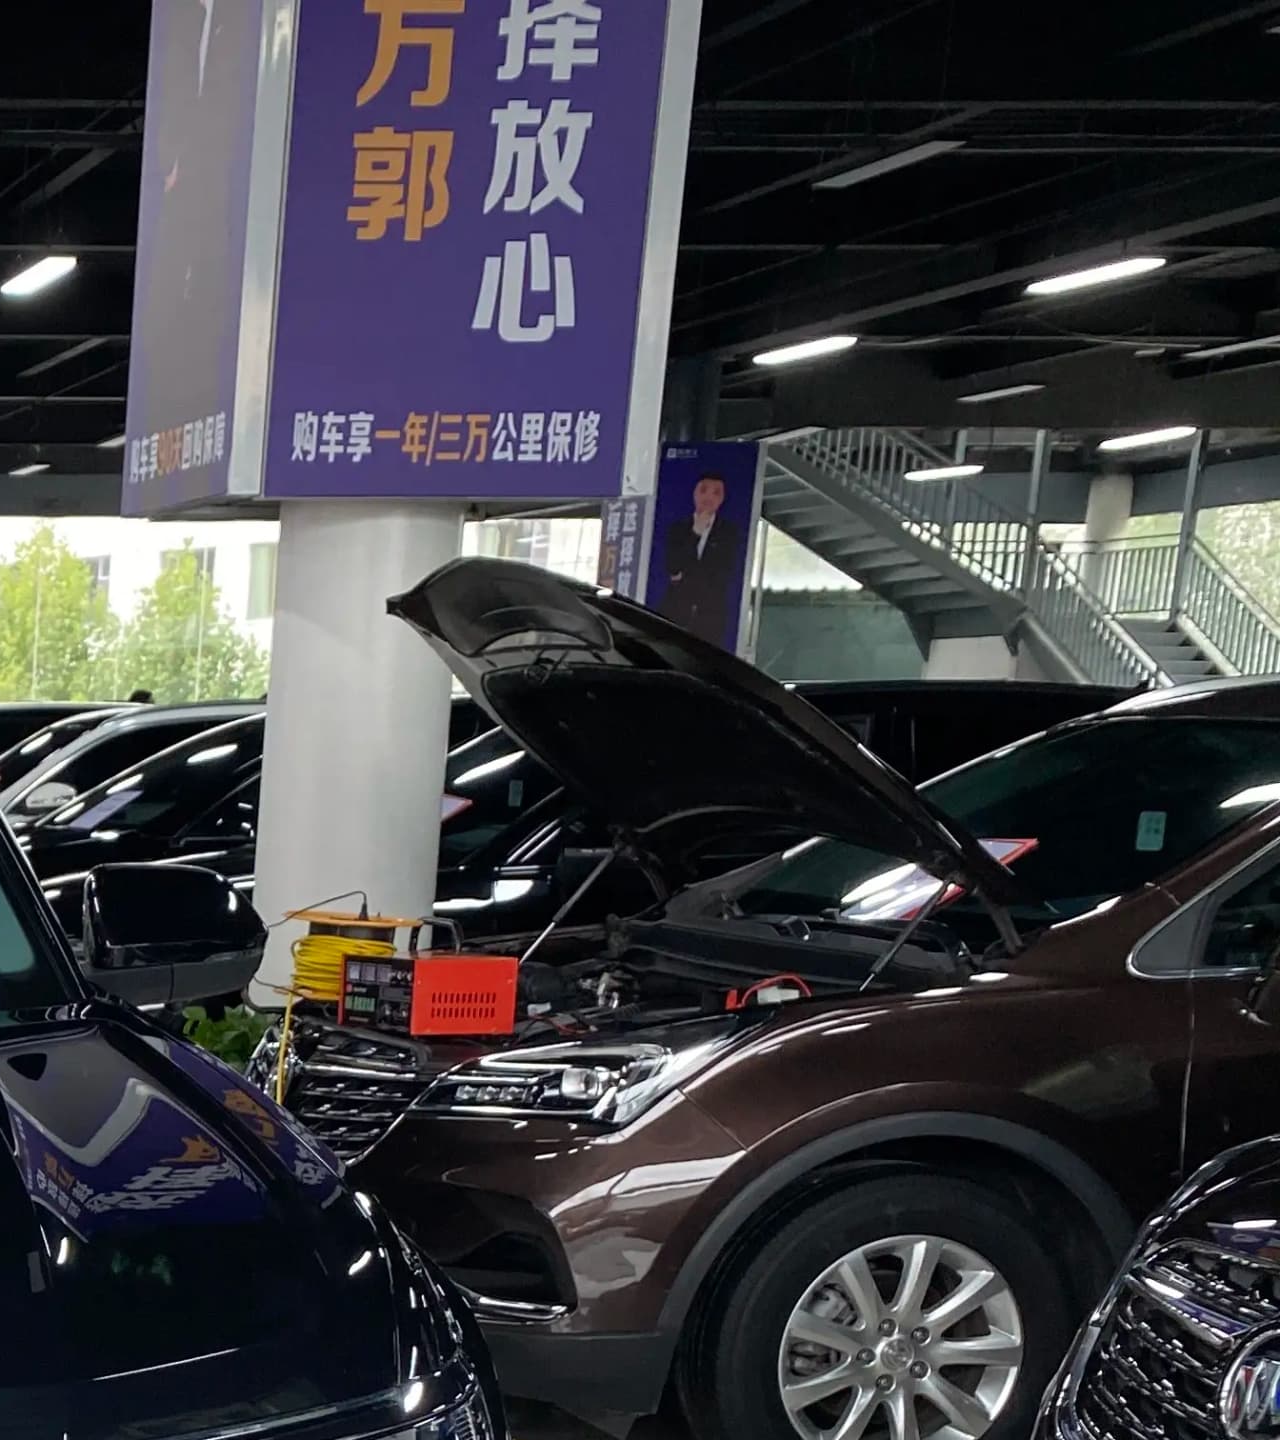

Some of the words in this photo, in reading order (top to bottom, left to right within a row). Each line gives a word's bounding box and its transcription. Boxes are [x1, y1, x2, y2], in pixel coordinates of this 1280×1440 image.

[347, 0, 465, 242] 万郭
[472, 0, 603, 343] 择放心
[290, 410, 601, 467] 购车享一年/三万公里保修
